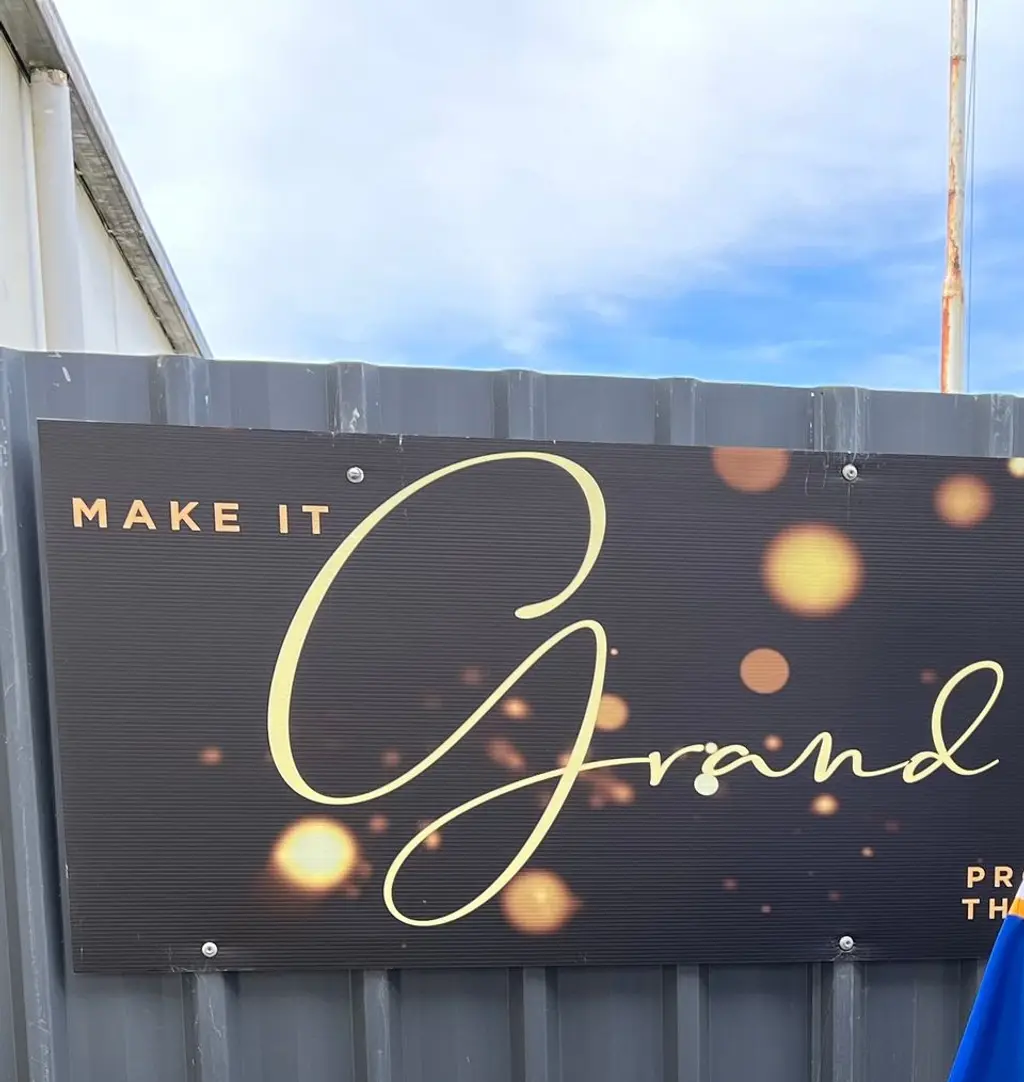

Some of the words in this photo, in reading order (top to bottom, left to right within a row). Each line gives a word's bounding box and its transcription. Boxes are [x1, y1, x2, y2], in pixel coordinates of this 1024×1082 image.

[71, 497, 241, 533] MAKE
[278, 503, 329, 535] IT
[267, 451, 1004, 927] Grand
